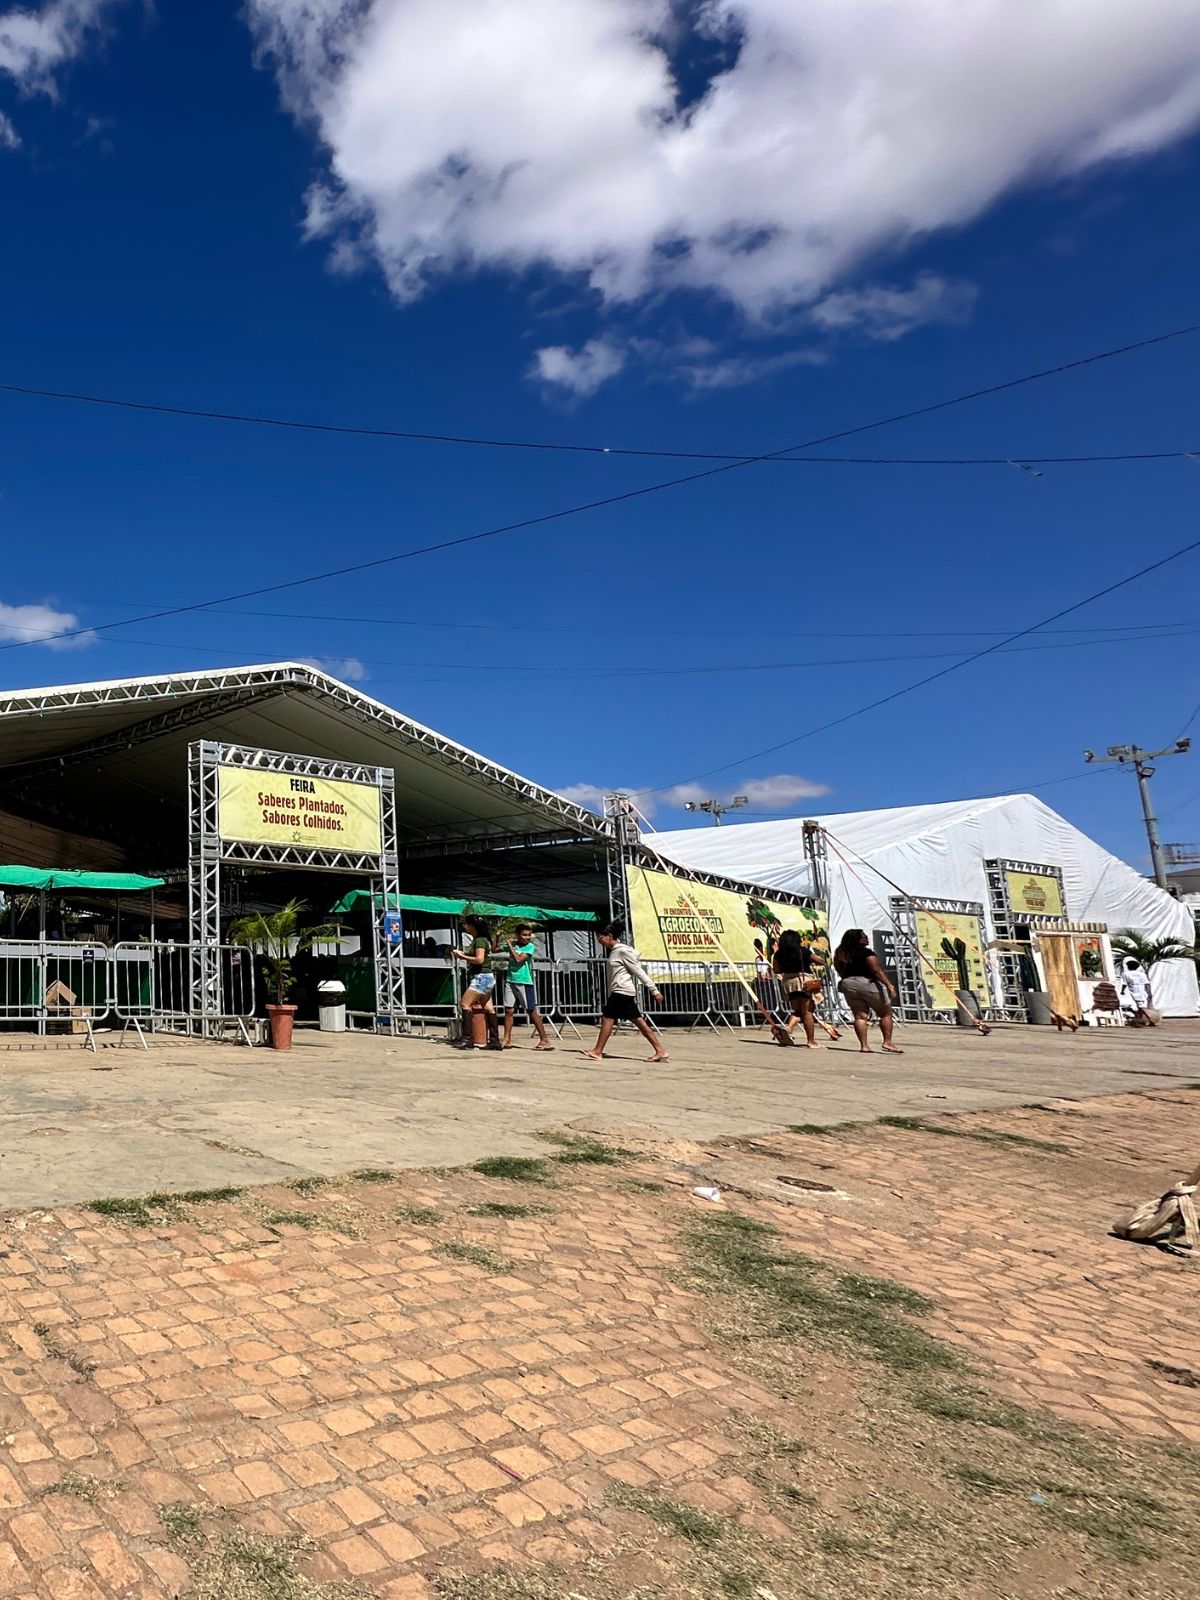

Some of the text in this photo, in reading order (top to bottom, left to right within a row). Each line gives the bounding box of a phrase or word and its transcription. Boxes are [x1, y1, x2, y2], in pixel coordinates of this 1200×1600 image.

[290, 778, 316, 794] FEIRA
[258, 792, 296, 809] Saberes
[262, 809, 344, 831] Sabores Colhidos.
[667, 934, 691, 945] POVOS
[693, 934, 703, 945] DA
